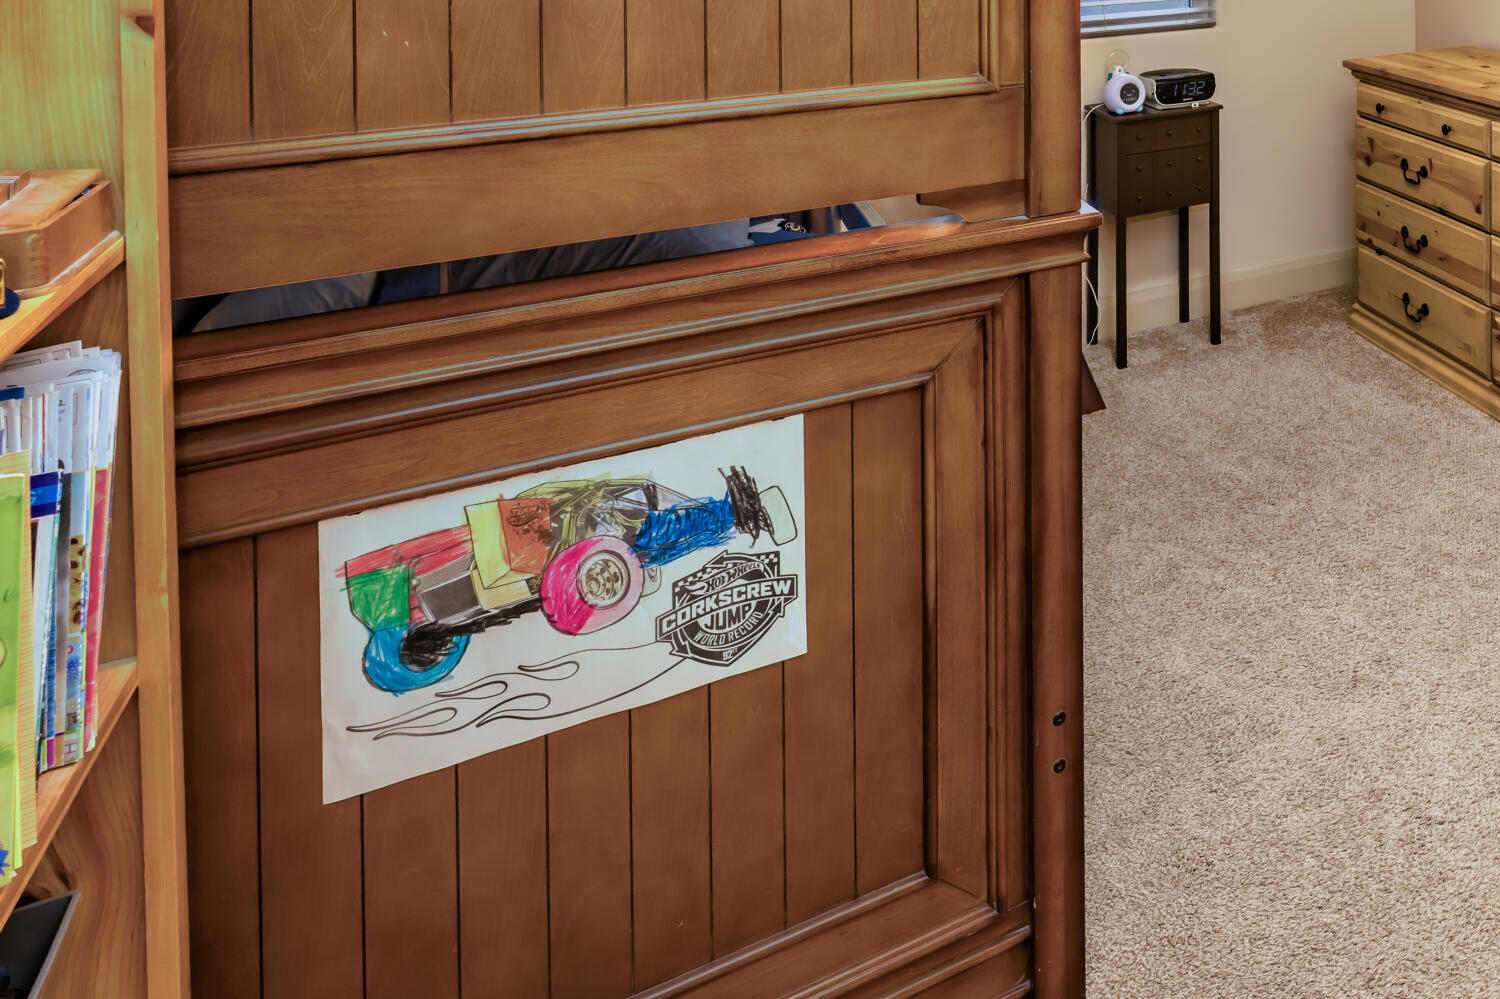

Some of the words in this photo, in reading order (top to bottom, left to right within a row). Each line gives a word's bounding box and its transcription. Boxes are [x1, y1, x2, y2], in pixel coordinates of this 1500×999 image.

[1174, 81, 1206, 97] 11:32
[662, 579, 792, 634] CORKSCREW
[704, 604, 751, 631] JUMP
[693, 629, 726, 646] WORLD
[728, 611, 764, 643] RECORD
